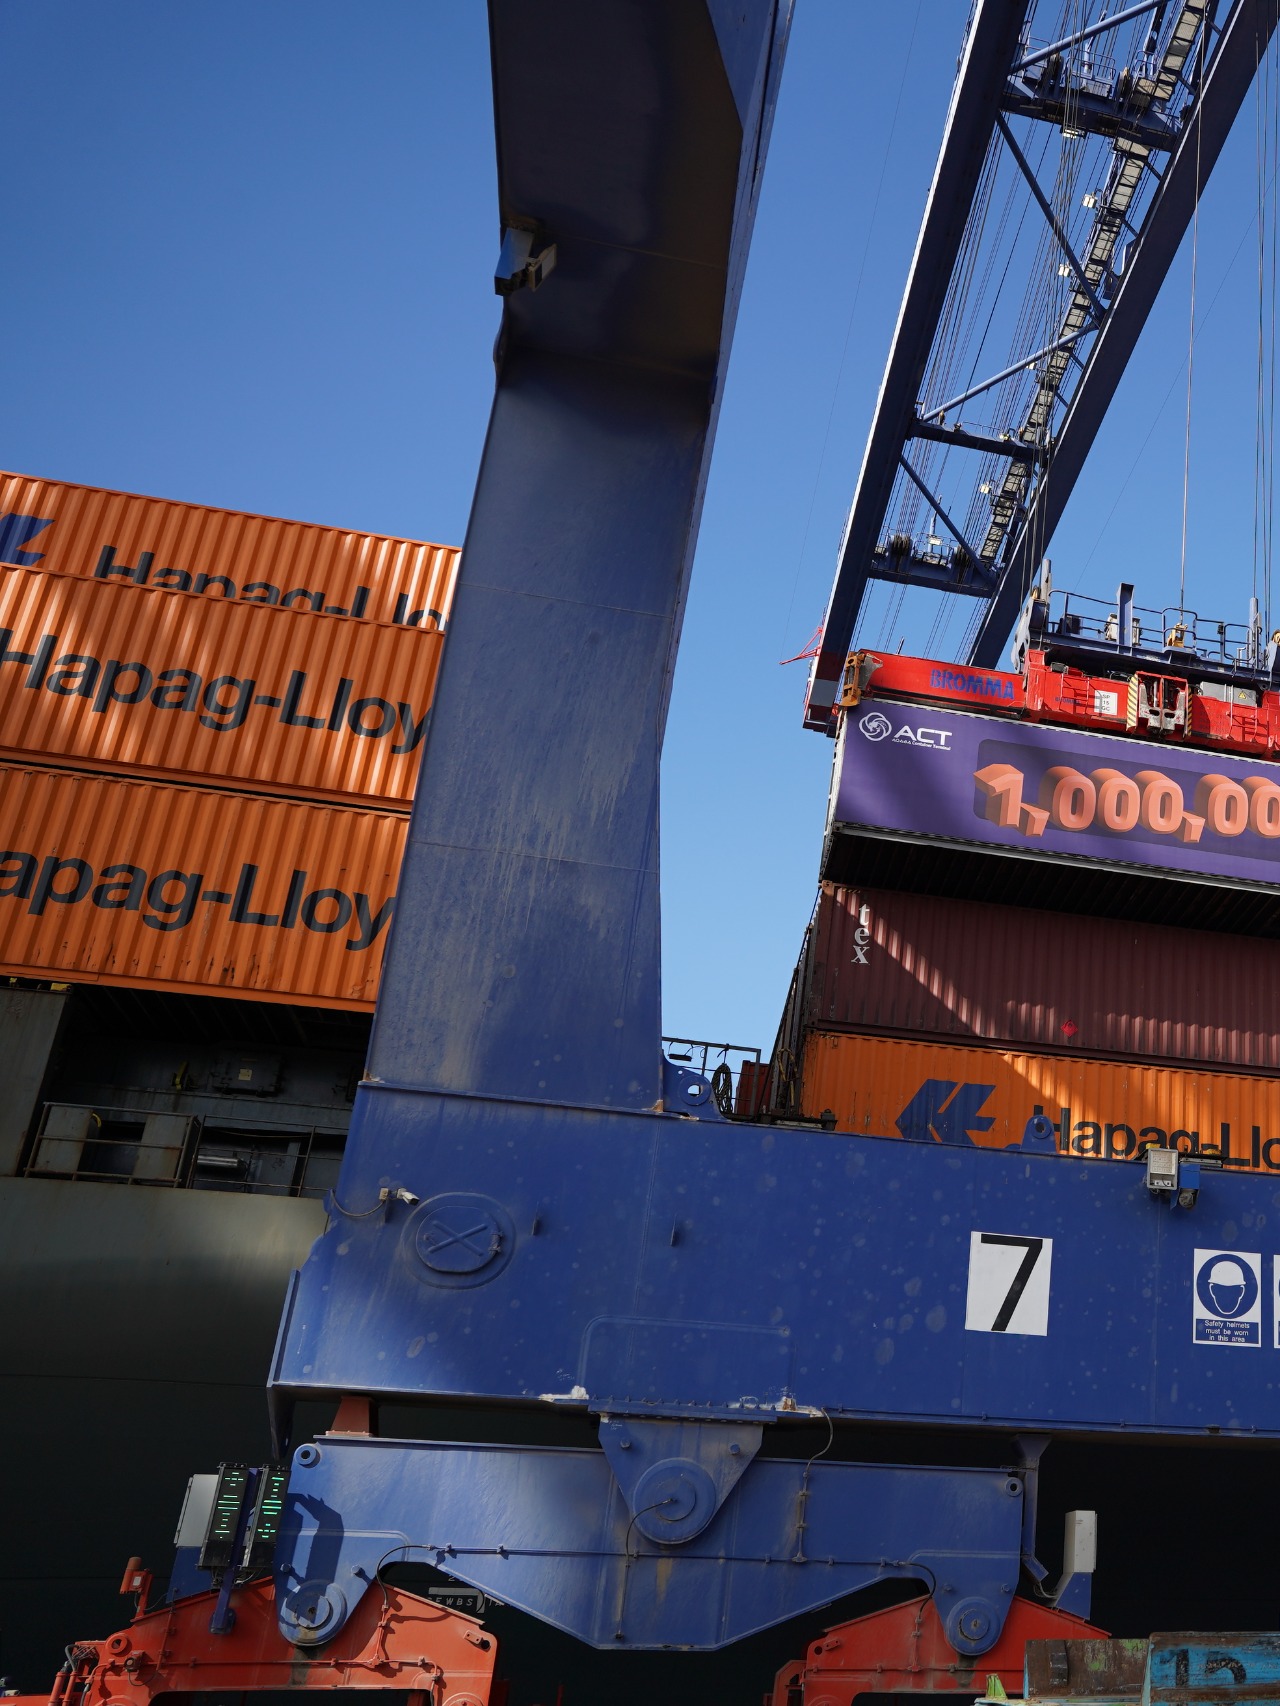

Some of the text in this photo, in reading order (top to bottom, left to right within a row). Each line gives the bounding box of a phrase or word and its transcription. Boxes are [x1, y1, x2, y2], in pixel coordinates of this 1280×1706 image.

[0, 628, 432, 755] Hapag-Lloy
[930, 669, 1014, 700] BROMMA
[894, 725, 953, 746] ACT
[0, 850, 396, 951] apag-Lloy
[981, 1233, 1043, 1332] 7
[1204, 1320, 1250, 1329] Safety helmets
